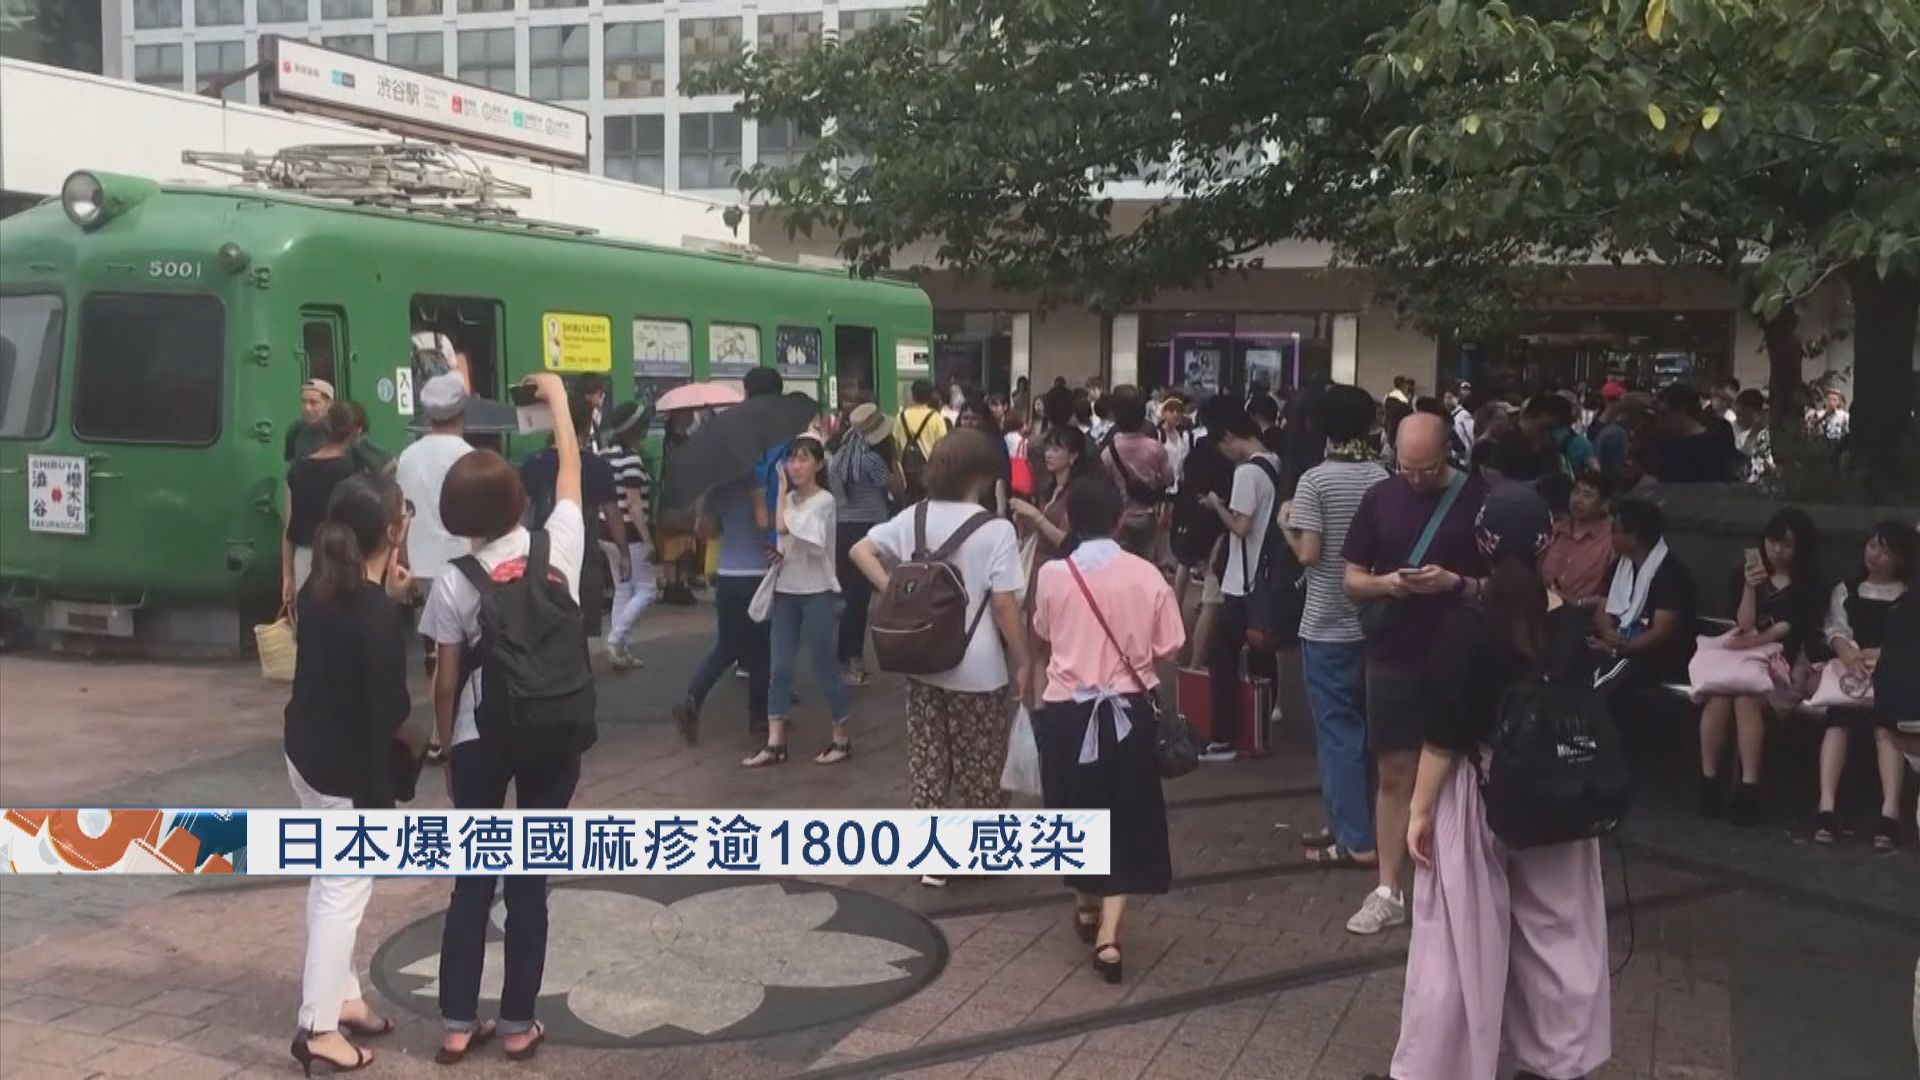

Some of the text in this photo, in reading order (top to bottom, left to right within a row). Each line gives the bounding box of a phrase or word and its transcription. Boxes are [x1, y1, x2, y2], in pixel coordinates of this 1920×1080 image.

[377, 74, 420, 107] 渋谷駅
[149, 260, 201, 278] 5001
[32, 460, 80, 470] SHIBUYA
